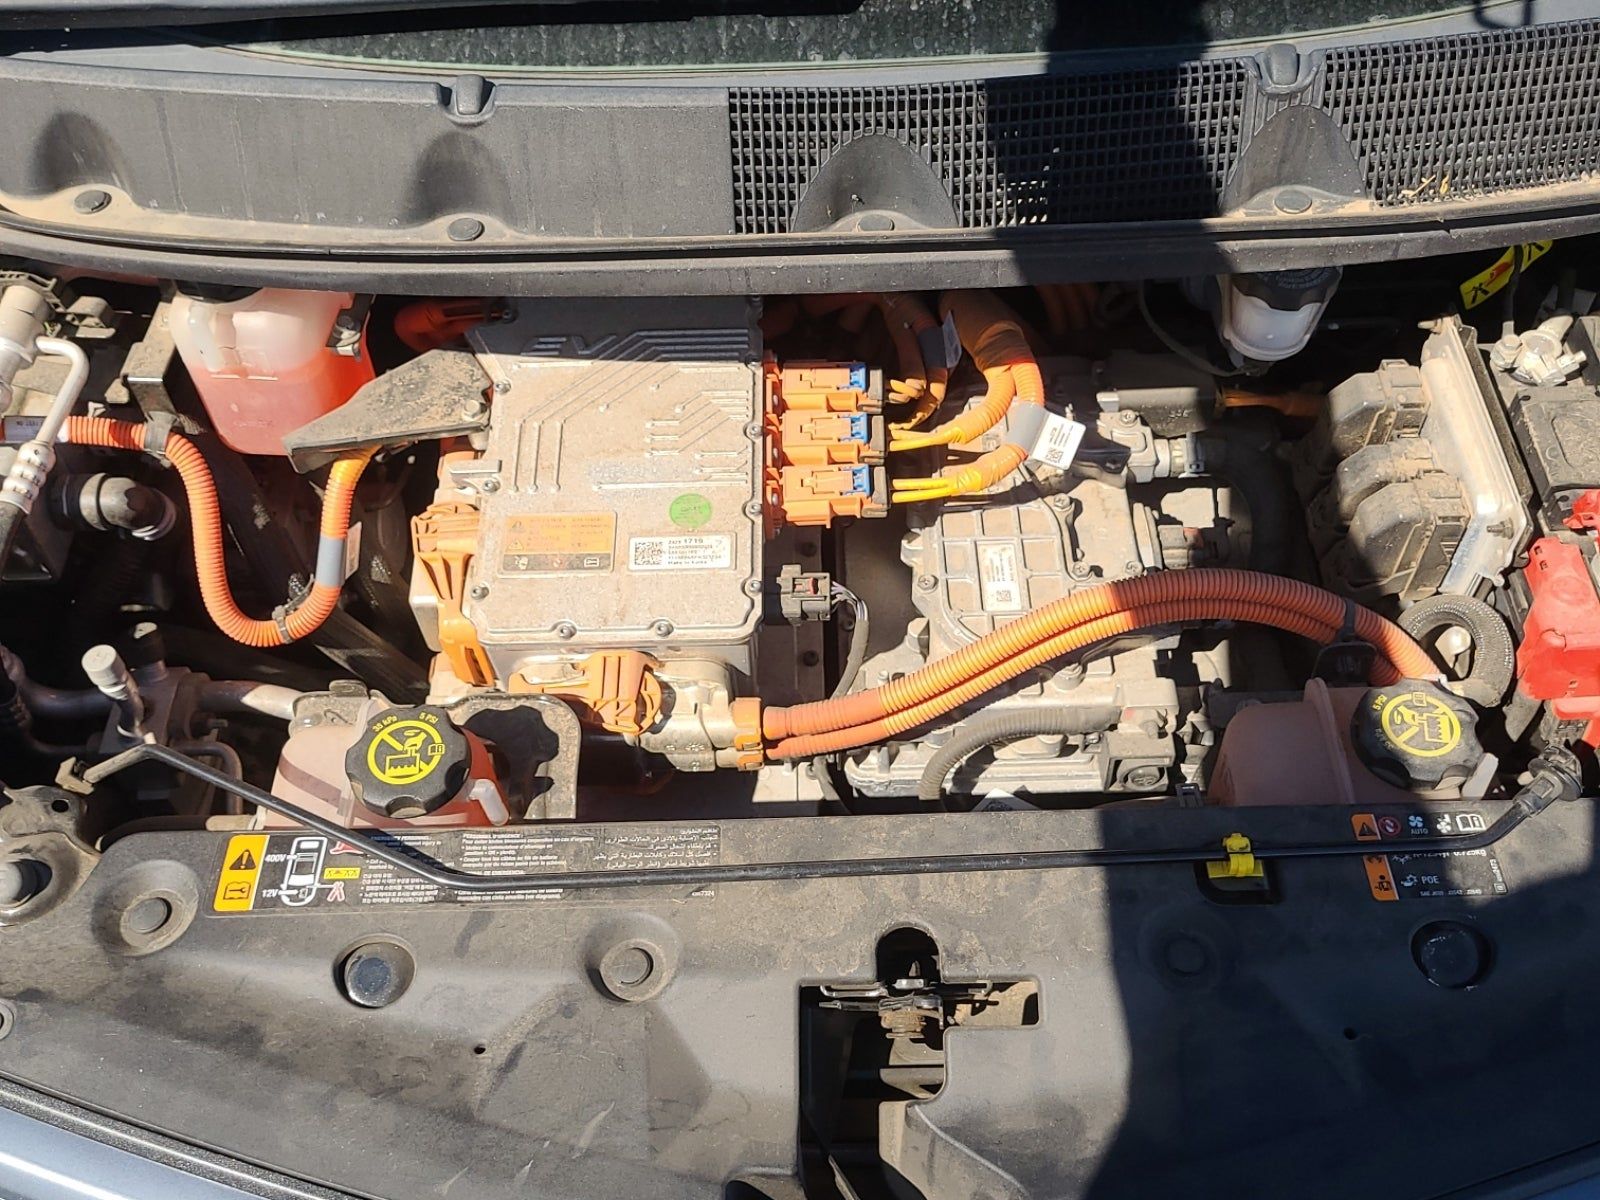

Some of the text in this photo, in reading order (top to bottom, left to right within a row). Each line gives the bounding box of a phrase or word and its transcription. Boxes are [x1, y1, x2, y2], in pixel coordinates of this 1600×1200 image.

[425, 713, 439, 724] PSI
[264, 854, 287, 862] 400V
[1421, 875, 1440, 884] POE
[262, 888, 279, 898] 12V
